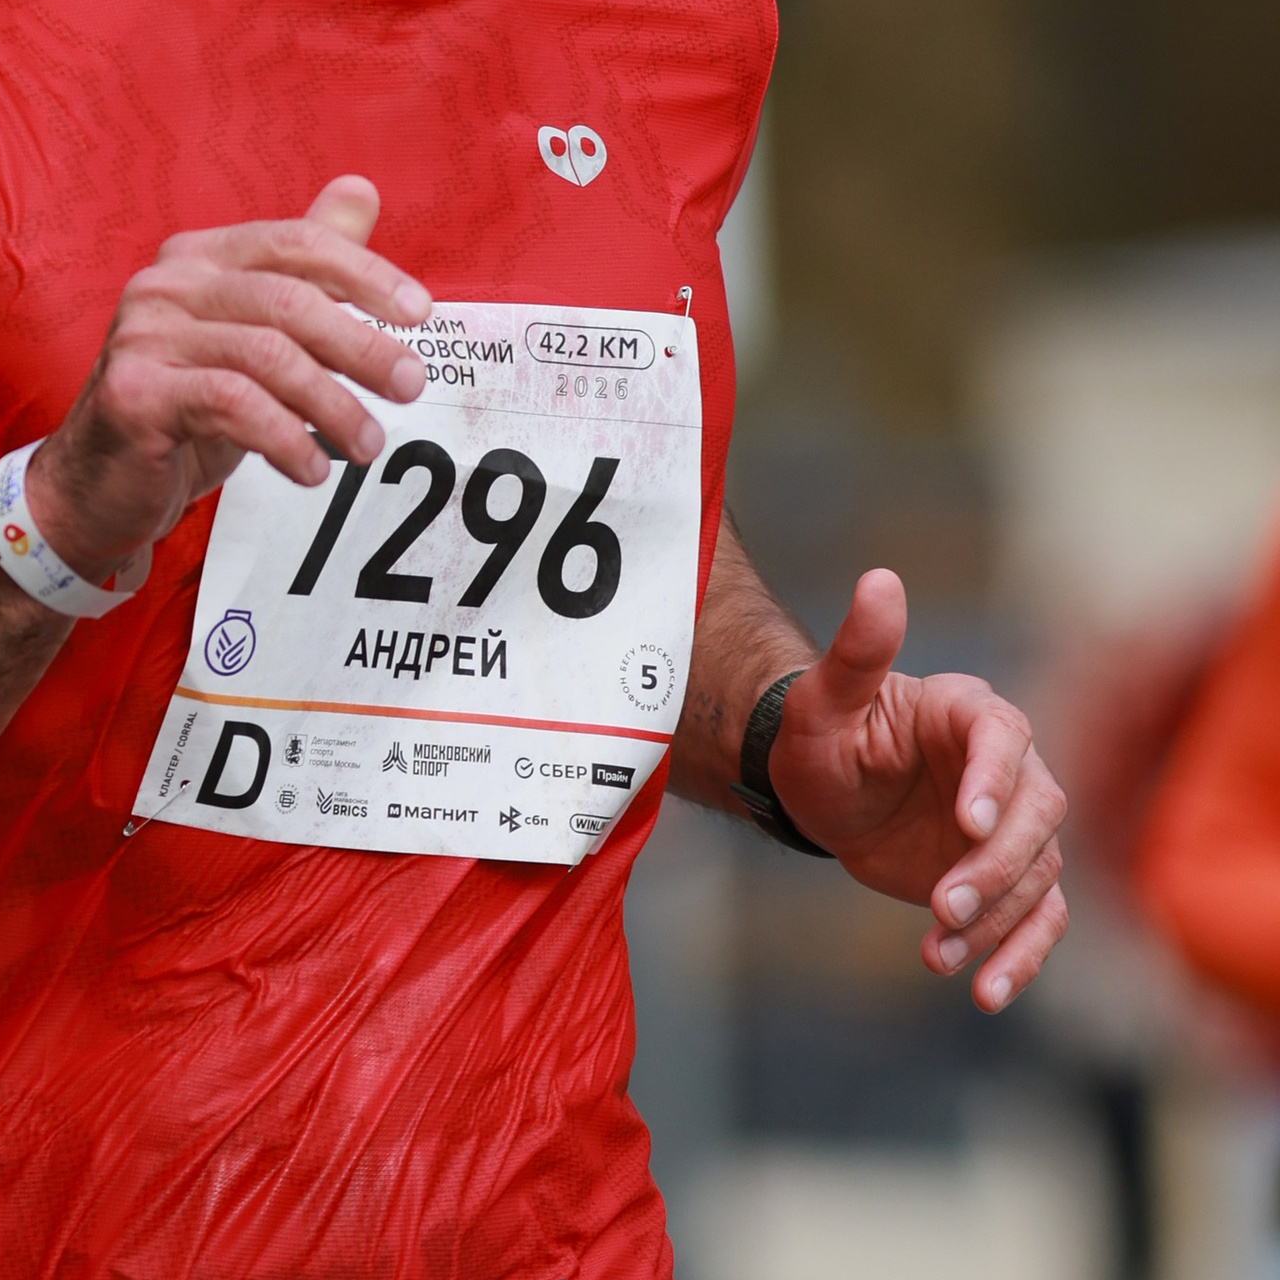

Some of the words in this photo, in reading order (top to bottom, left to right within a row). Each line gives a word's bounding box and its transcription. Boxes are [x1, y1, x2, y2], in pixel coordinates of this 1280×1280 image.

[540, 331, 588, 359] 42,2
[555, 373, 629, 400] 2026
[286, 431, 622, 619] 7296
[343, 627, 508, 681] АНДРЕЙ
[641, 664, 658, 690] 5
[158, 753, 180, 798] КЛАСТЕР
[178, 711, 197, 748] CORRAL
[195, 720, 272, 809] D
[413, 743, 491, 763] МОСКОВСКИЙ
[412, 760, 449, 777] СПОРТ
[539, 763, 588, 779] СБЕР
[596, 768, 629, 783] Прайм
[332, 804, 368, 818] BRICS
[524, 814, 549, 827] сбп
